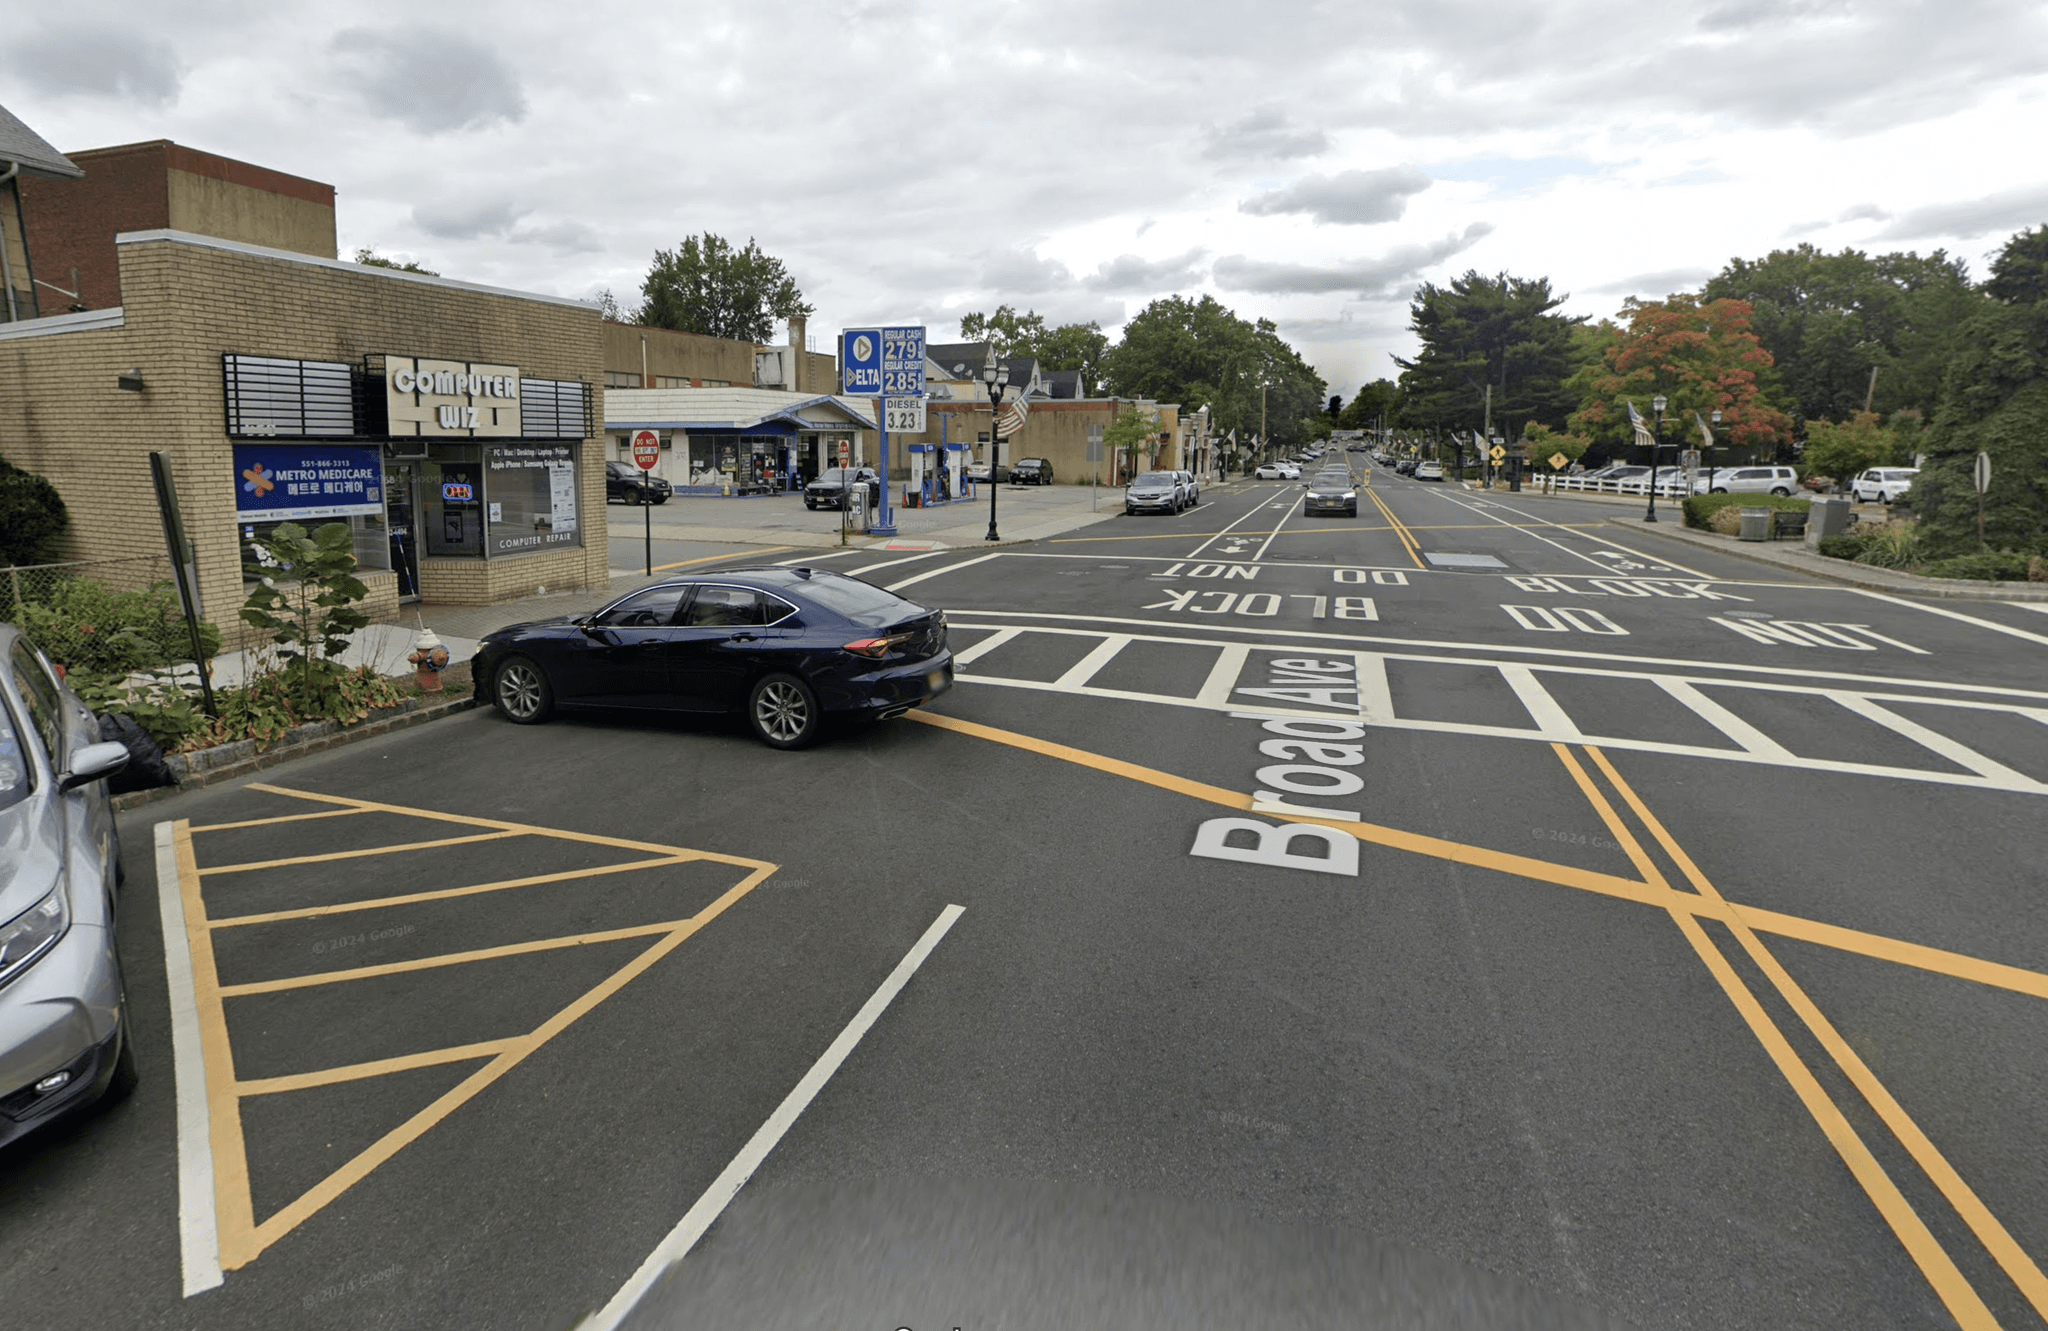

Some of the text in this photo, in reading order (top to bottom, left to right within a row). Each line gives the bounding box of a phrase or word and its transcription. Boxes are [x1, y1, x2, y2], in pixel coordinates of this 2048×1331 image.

[885, 341, 917, 360] 2.79
[395, 369, 516, 398] COMPUTER
[846, 367, 880, 387] DELTA
[885, 372, 917, 391] 2.85
[887, 400, 921, 409] DIESEL
[440, 405, 480, 428] WIZ
[888, 412, 915, 428] 3.23
[516, 449, 535, 457] Desktop
[638, 455, 655, 463] ENTER
[491, 461, 504, 470] Apple
[524, 460, 543, 468] Samsung
[275, 468, 373, 481] METRO MEDICARE
[287, 481, 363, 495] 메트로 메디케어
[446, 486, 470, 498] OPEN
[500, 532, 571, 549] COMPUTER REPAIR
[1150, 562, 1410, 586] DO NOT
[1501, 576, 1755, 601] BLOCK
[1141, 589, 1380, 621] BLOCK
[1500, 604, 1933, 655] DO NOT
